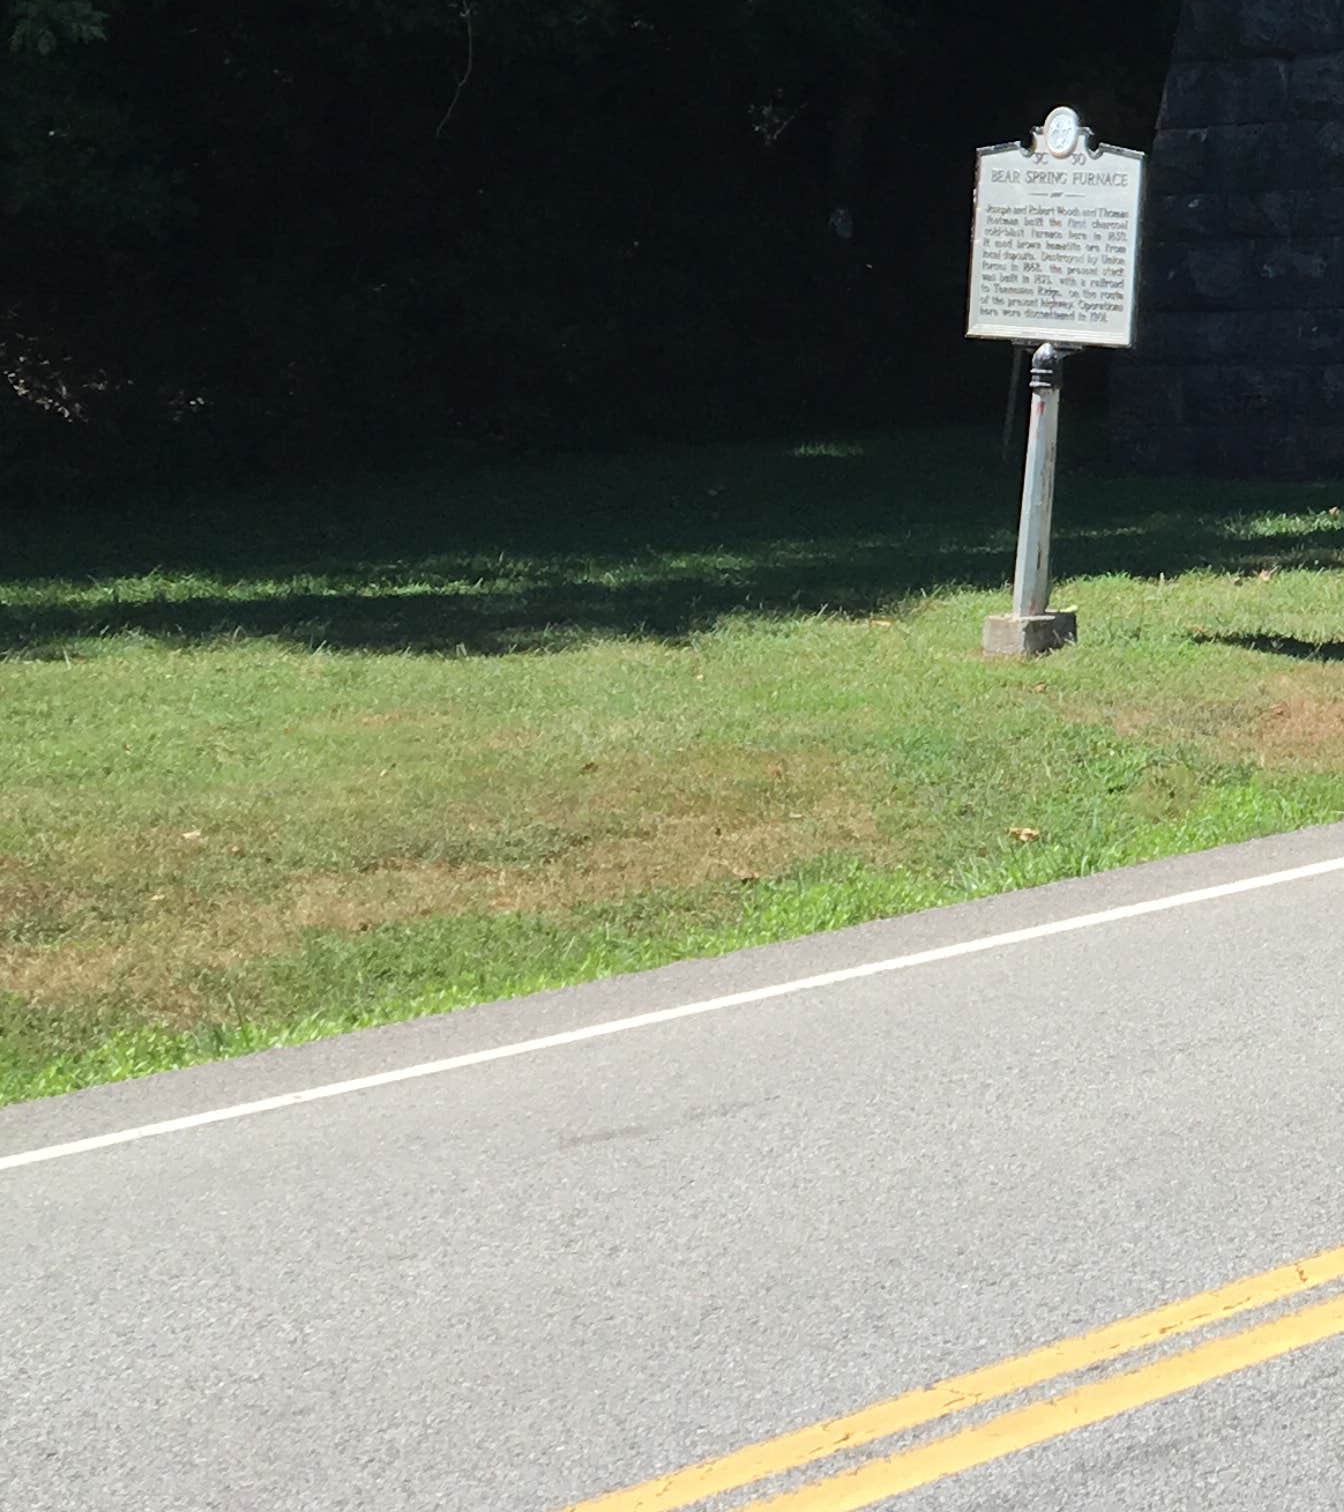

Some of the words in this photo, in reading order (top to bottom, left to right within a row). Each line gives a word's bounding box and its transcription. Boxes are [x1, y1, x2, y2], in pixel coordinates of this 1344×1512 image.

[992, 170, 1020, 184] BEAR
[1025, 170, 1067, 185] SPRING
[1072, 172, 1128, 187] FURNACE
